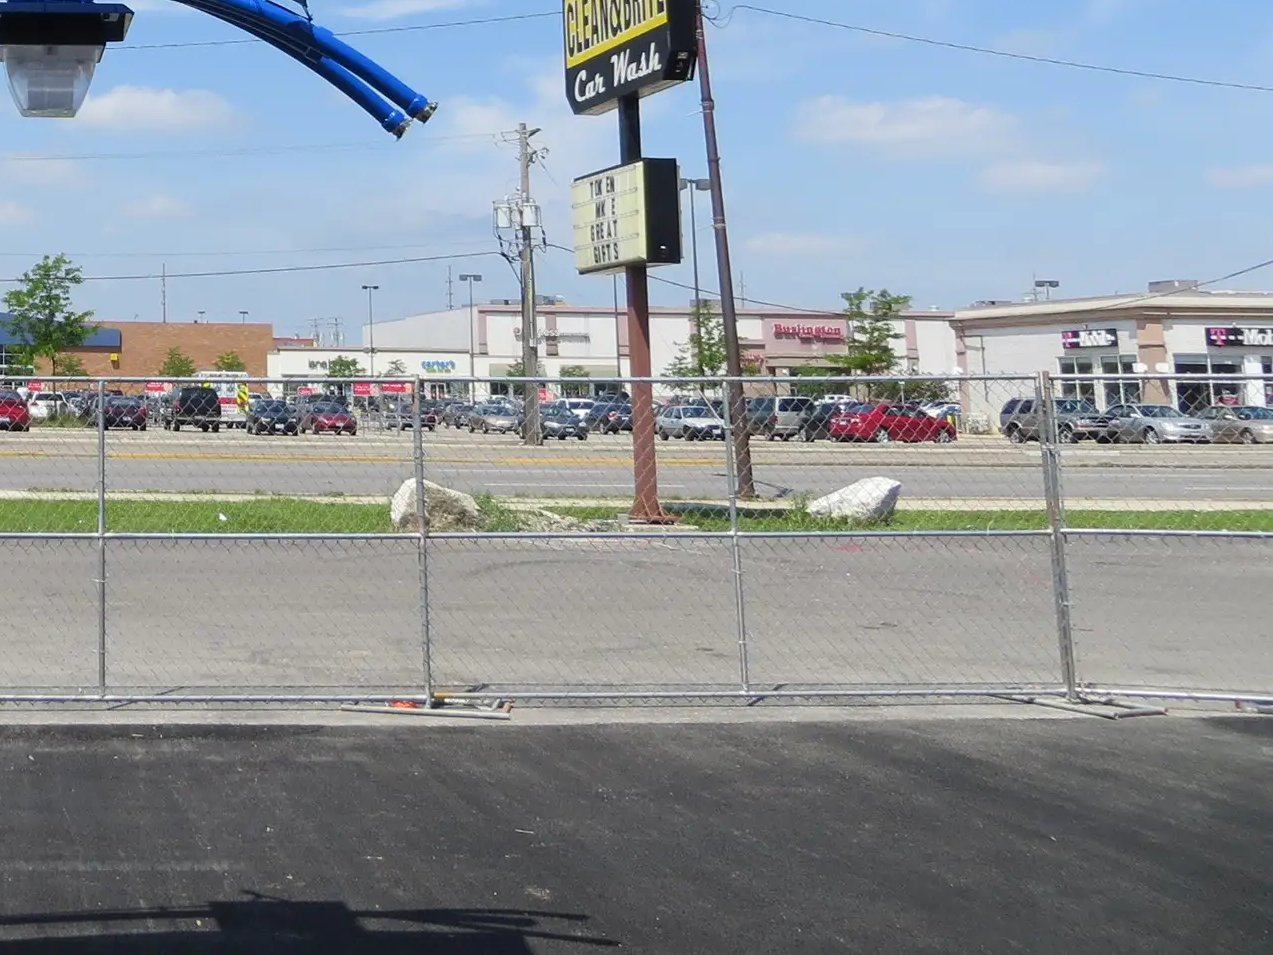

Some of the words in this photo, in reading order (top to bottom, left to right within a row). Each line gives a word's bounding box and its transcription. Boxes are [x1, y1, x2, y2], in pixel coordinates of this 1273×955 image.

[575, 69, 606, 102] Car
[610, 42, 662, 87] Wash
[590, 219, 618, 242] GREAT
[593, 243, 619, 264] GIFTS
[774, 323, 841, 338] Burlington
